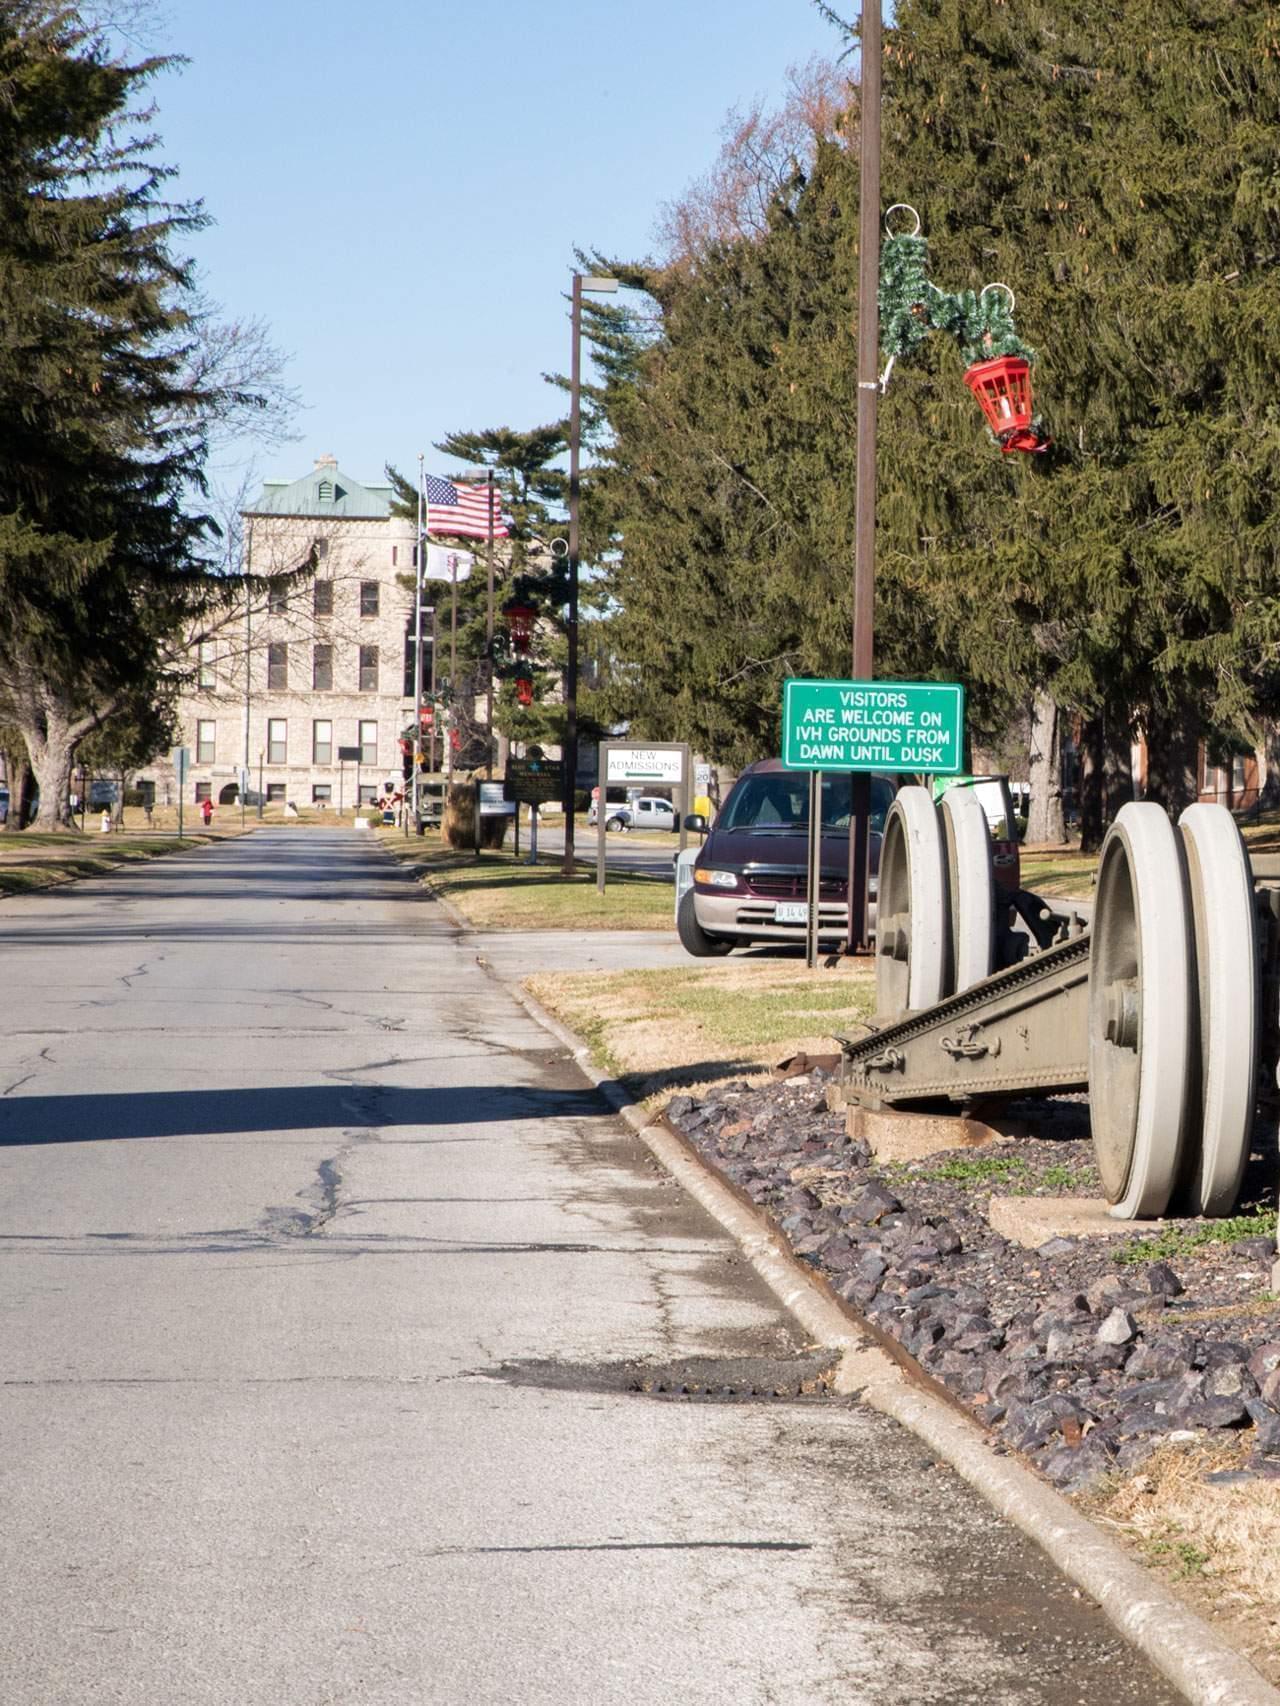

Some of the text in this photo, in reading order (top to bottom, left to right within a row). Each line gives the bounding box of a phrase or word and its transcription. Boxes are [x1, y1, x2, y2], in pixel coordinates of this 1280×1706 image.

[839, 691, 907, 708] VISITORS
[803, 708, 942, 726] ARE WELCOME ON
[796, 726, 950, 744] IVH GROUNDS FROM
[631, 751, 657, 760] NEW
[800, 744, 943, 762] DAWN UNTIL DUSK
[609, 761, 679, 771] ADMISSIONS
